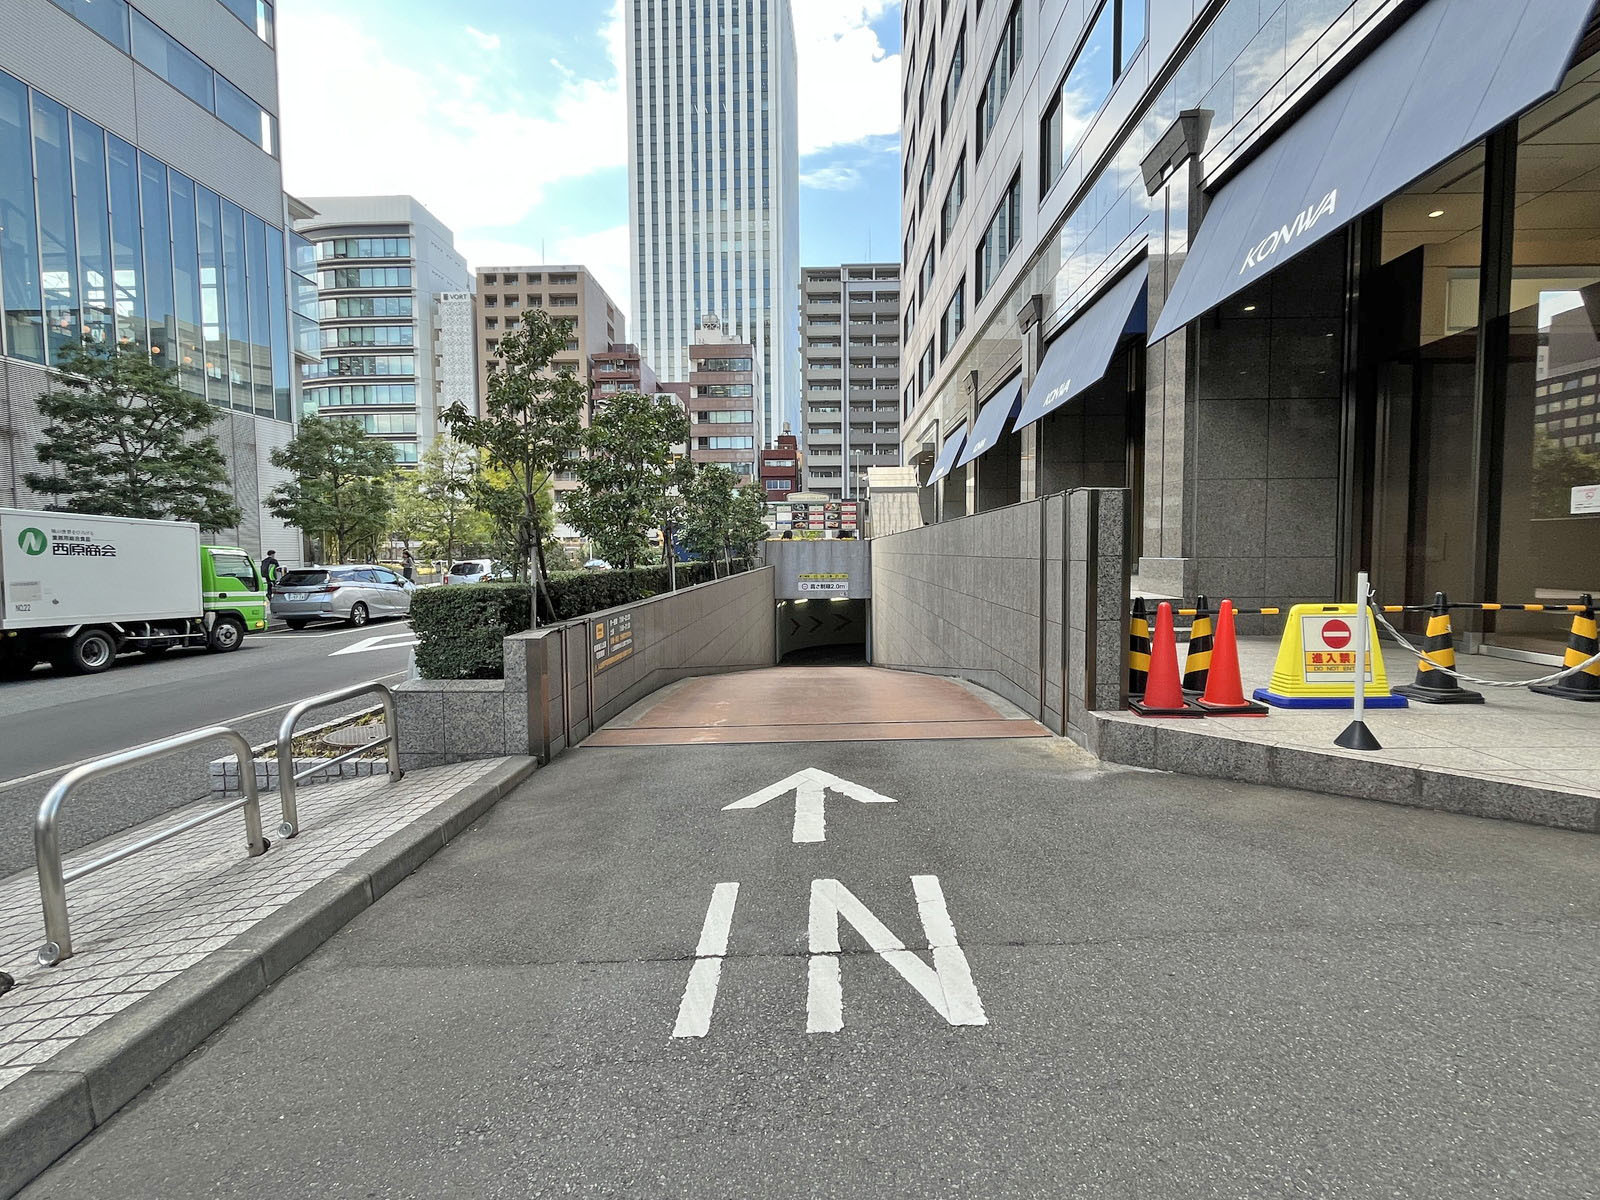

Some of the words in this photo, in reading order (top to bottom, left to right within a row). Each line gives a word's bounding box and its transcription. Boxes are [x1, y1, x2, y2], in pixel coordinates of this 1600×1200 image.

[1238, 189, 1338, 276] KONWA
[52, 542, 116, 557] 西原商会
[671, 874, 989, 1039] IN
